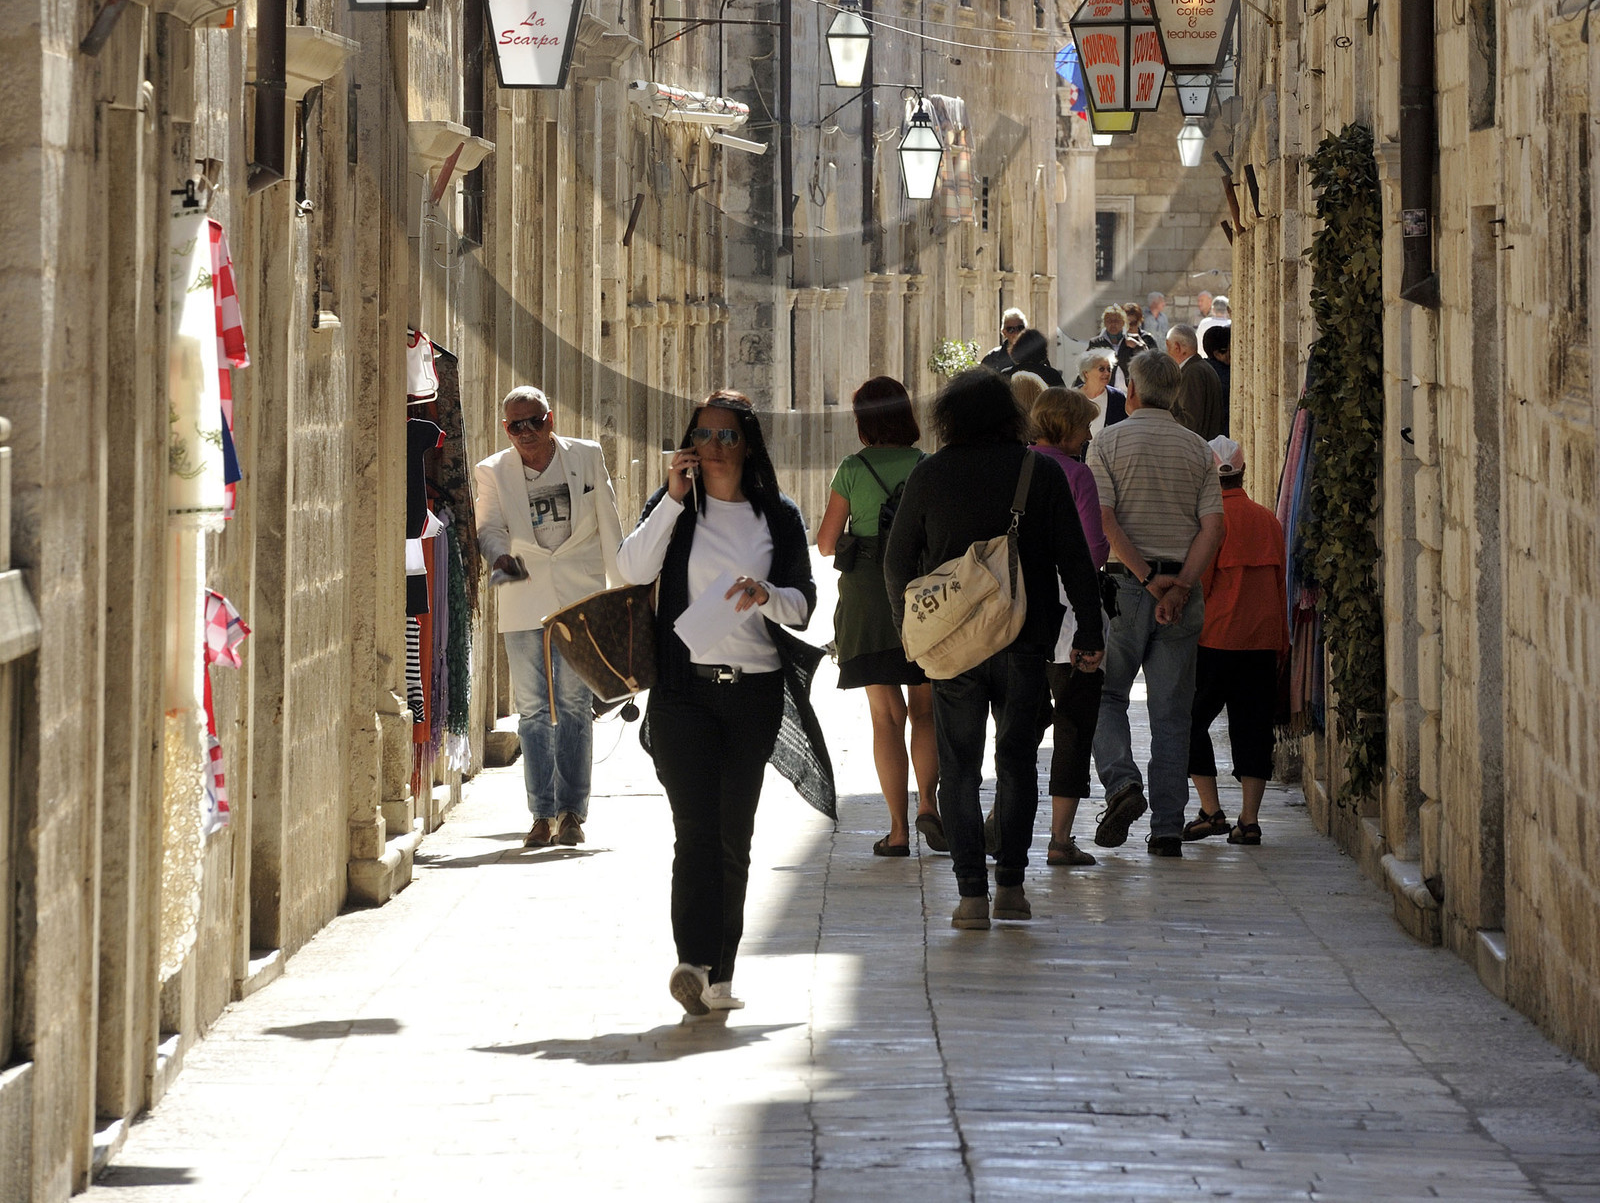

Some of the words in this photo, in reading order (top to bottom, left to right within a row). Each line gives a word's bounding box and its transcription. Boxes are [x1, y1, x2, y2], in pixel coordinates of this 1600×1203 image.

[519, 11, 546, 27] La
[1092, 6, 1112, 17] SHOP
[1176, 6, 1214, 16] coffee
[1187, 15, 1198, 28] &
[498, 29, 561, 49] Scarpa
[1167, 29, 1218, 39] teahouse
[1082, 33, 1120, 69] SOUVENIRS
[1096, 74, 1116, 104] SHOP
[1135, 72, 1155, 102] SHOP
